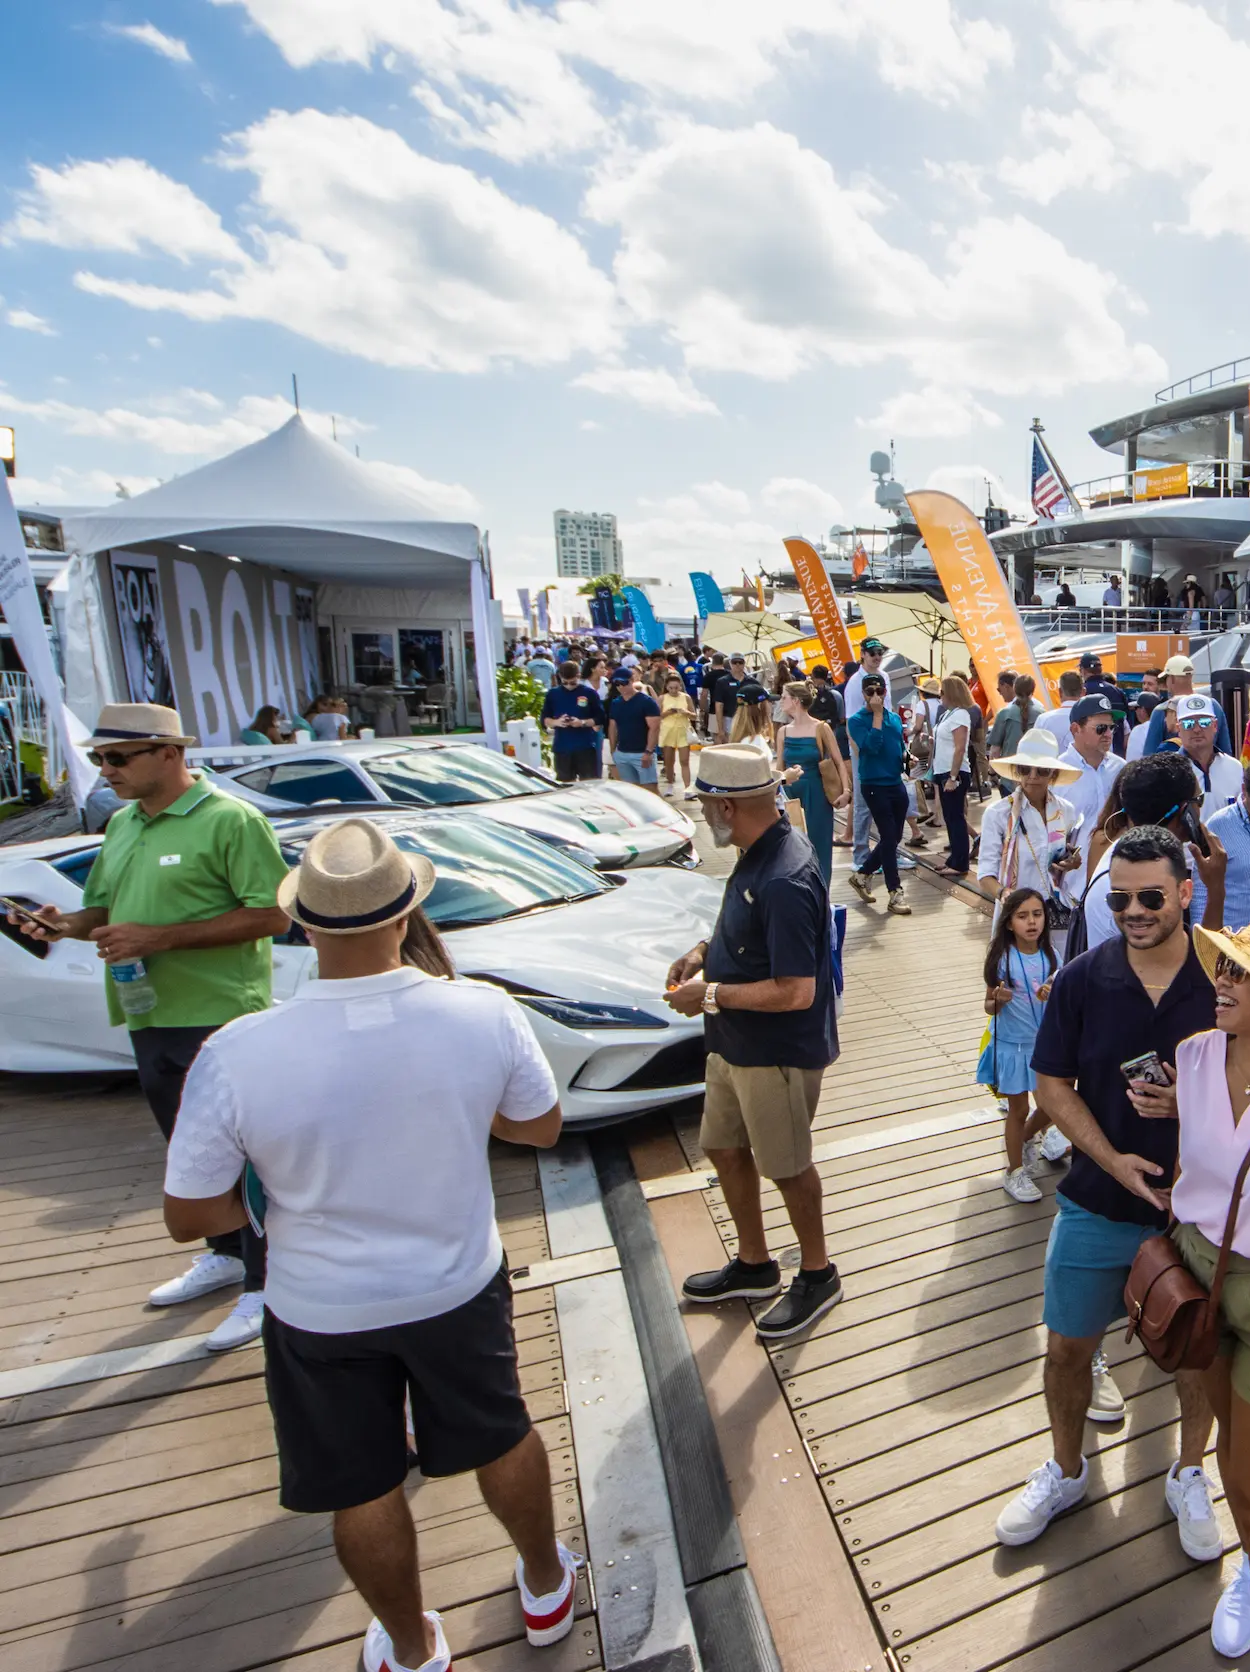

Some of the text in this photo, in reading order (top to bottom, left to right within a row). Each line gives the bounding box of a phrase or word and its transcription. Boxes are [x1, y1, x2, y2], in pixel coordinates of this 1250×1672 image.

[114, 568, 163, 623] BOAT
[796, 555, 826, 616] AVENUE
[821, 583, 842, 637] YACHTS
[173, 558, 299, 748] BOAT
[817, 616, 845, 677] WORTH
